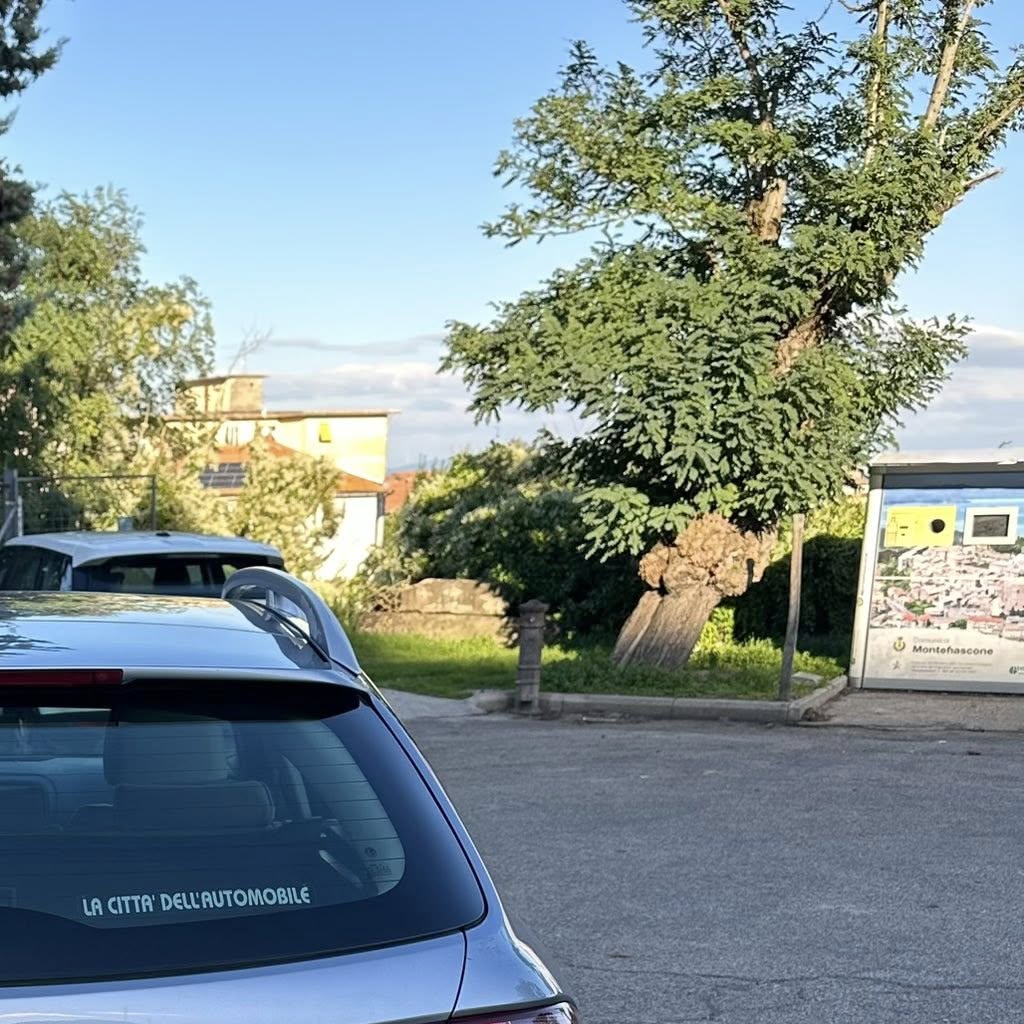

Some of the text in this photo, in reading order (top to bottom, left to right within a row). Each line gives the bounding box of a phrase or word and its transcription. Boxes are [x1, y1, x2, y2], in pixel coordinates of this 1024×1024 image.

[912, 645, 994, 656] Montefiascone
[82, 886, 311, 917] LA CITTA' DELL'AUTOMOBILE
